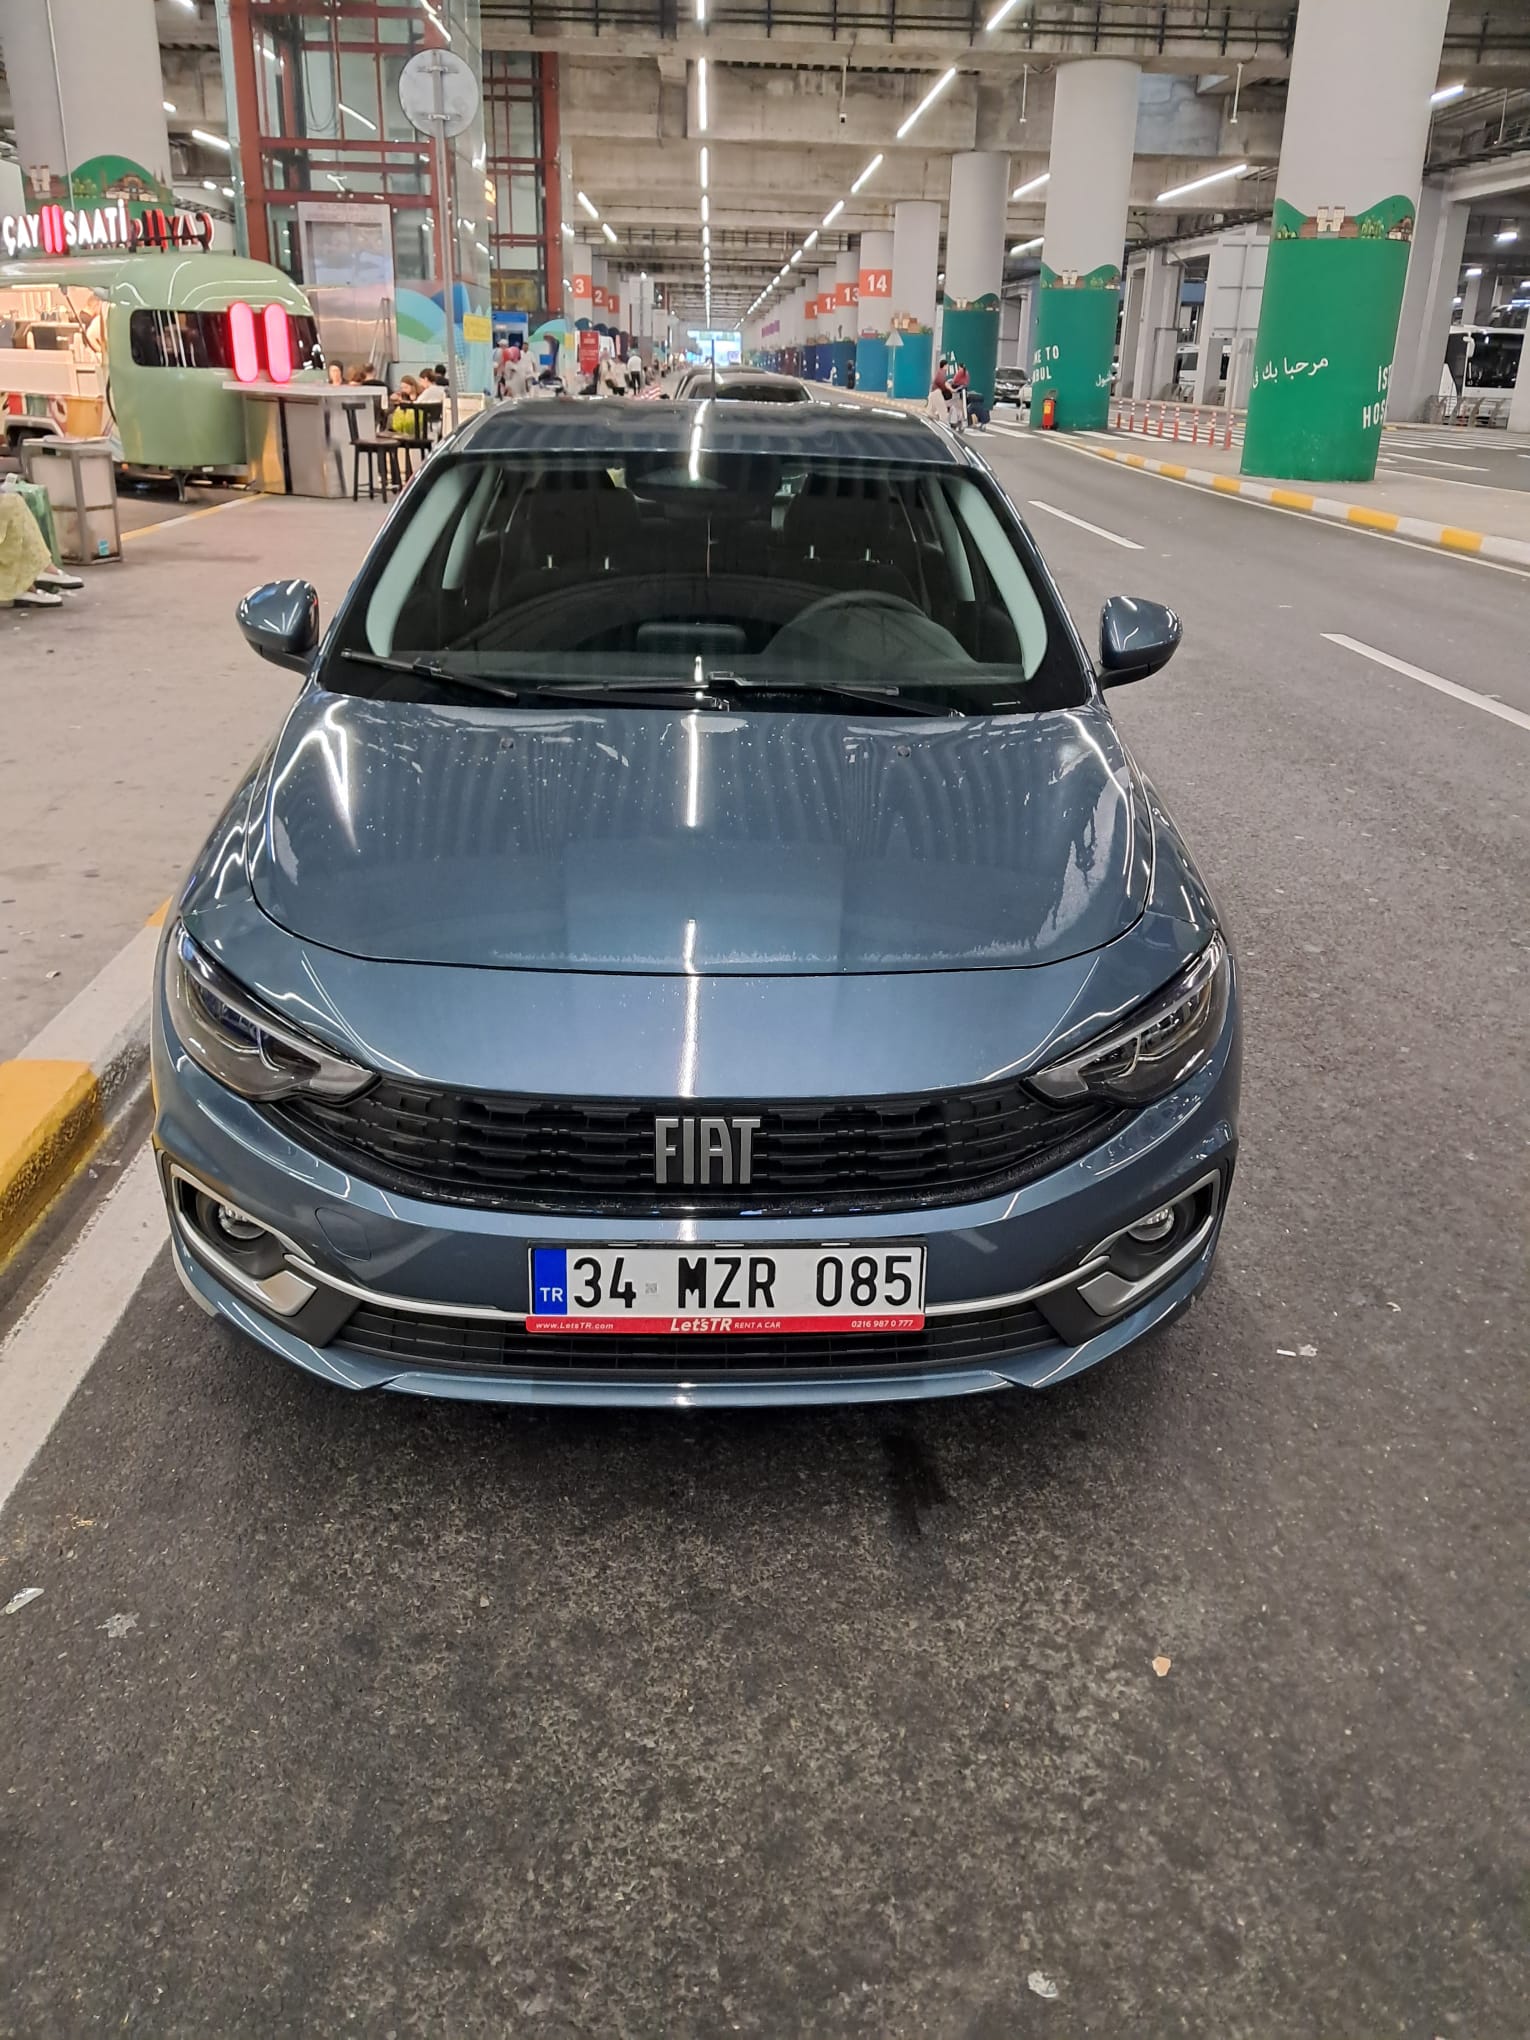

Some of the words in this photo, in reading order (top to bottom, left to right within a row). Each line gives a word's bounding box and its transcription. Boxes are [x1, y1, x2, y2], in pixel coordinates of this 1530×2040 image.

[3, 214, 39, 257] ÇAY
[63, 199, 128, 246] SAATİ
[575, 278, 584, 294] 3
[868, 274, 888, 293] 14
[594, 289, 603, 303] 2
[844, 287, 859, 302] 13
[608, 298, 614, 310] 1
[1045, 345, 1059, 361] TO
[1262, 360, 1278, 383] بك
[1283, 356, 1329, 380] مرحبا
[655, 1117, 761, 1184] FIAT
[573, 1256, 637, 1308] 34
[678, 1256, 776, 1308] MZR
[816, 1255, 912, 1307] 085
[540, 1287, 563, 1302] TR
[535, 1321, 614, 1330] www.LetsTR.com
[734, 1321, 755, 1329] RENT
[756, 1321, 763, 1329] A
[764, 1321, 781, 1329] CAR
[851, 1320, 871, 1328] 0216
[873, 1320, 889, 1328] 987
[898, 1319, 913, 1327] 777
